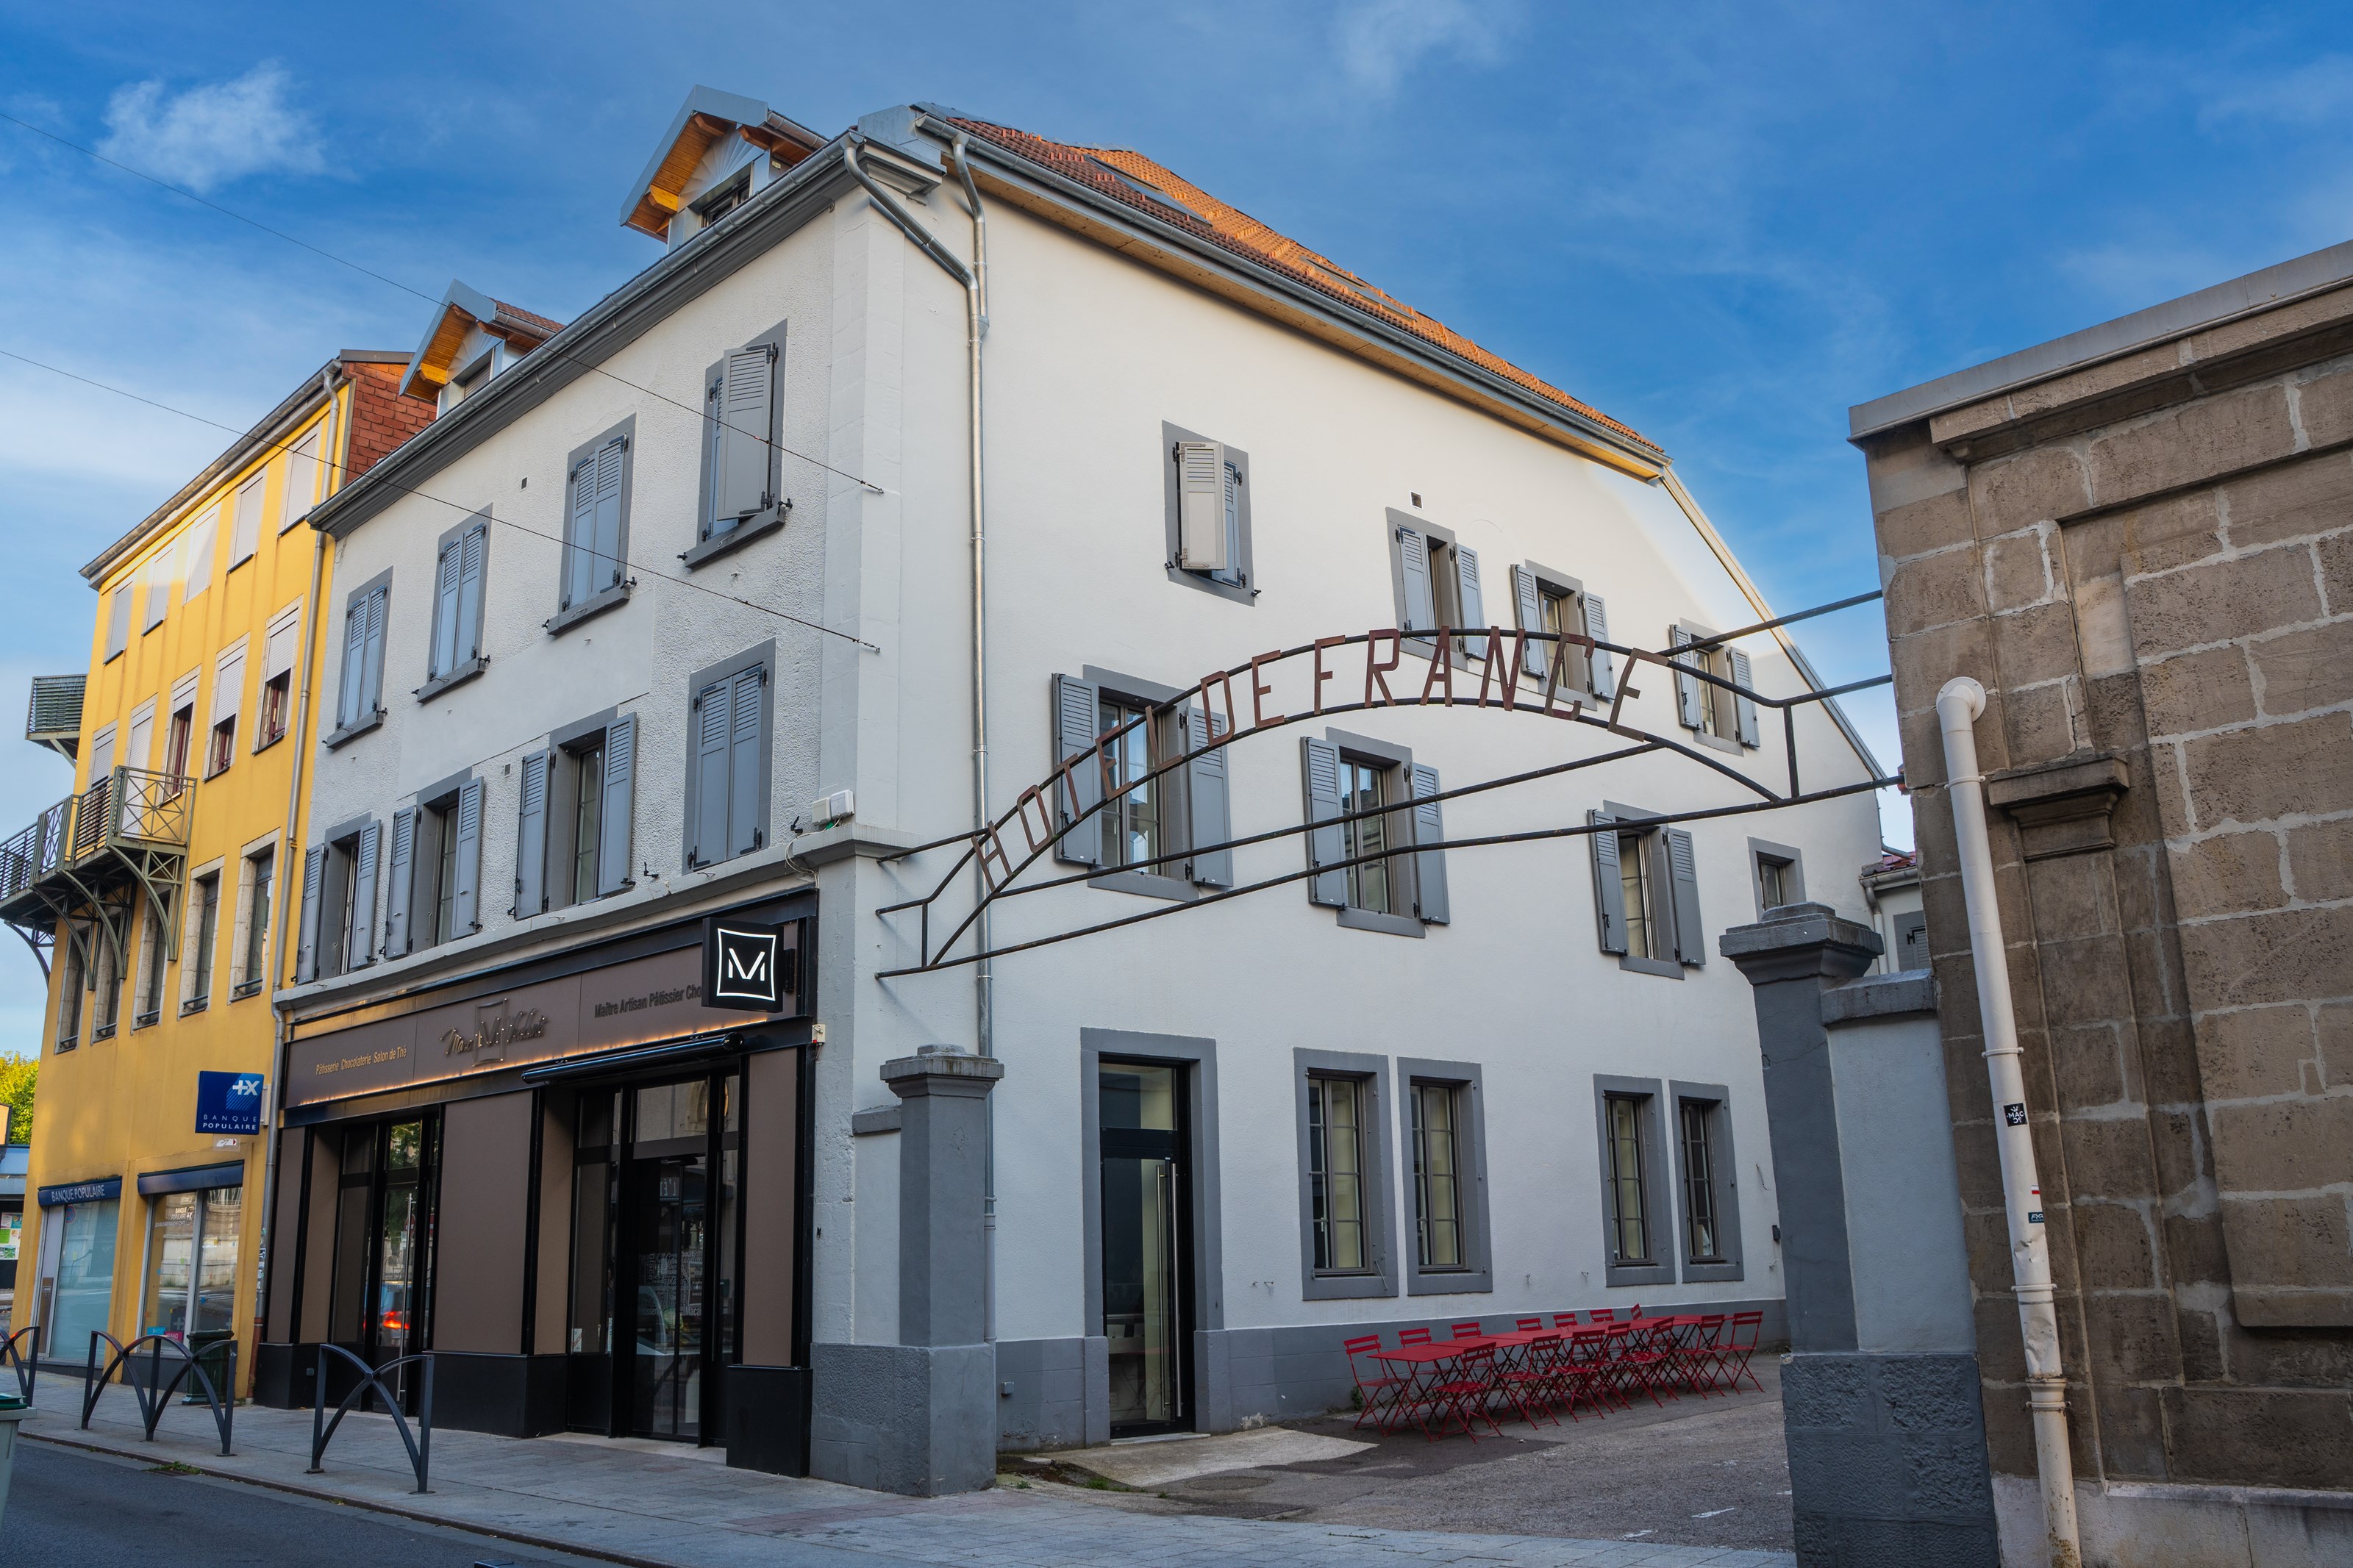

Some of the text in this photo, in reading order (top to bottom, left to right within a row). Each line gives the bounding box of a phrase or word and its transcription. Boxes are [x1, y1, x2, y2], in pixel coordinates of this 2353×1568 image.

[971, 625, 1669, 893] HOTEL DE FRANCE
[594, 1001, 619, 1019] Maître
[619, 997, 648, 1014] Artisan
[649, 988, 685, 1008] Pâtissier
[316, 1045, 407, 1075] Pâtisserie Chocolaterie Salon de Thé
[202, 1123, 257, 1131] POPULAIRE
[204, 1114, 257, 1123] BANQUE
[51, 1185, 105, 1203] BANQUE POPULAIRE
[175, 1206, 188, 1214] BANQUE
